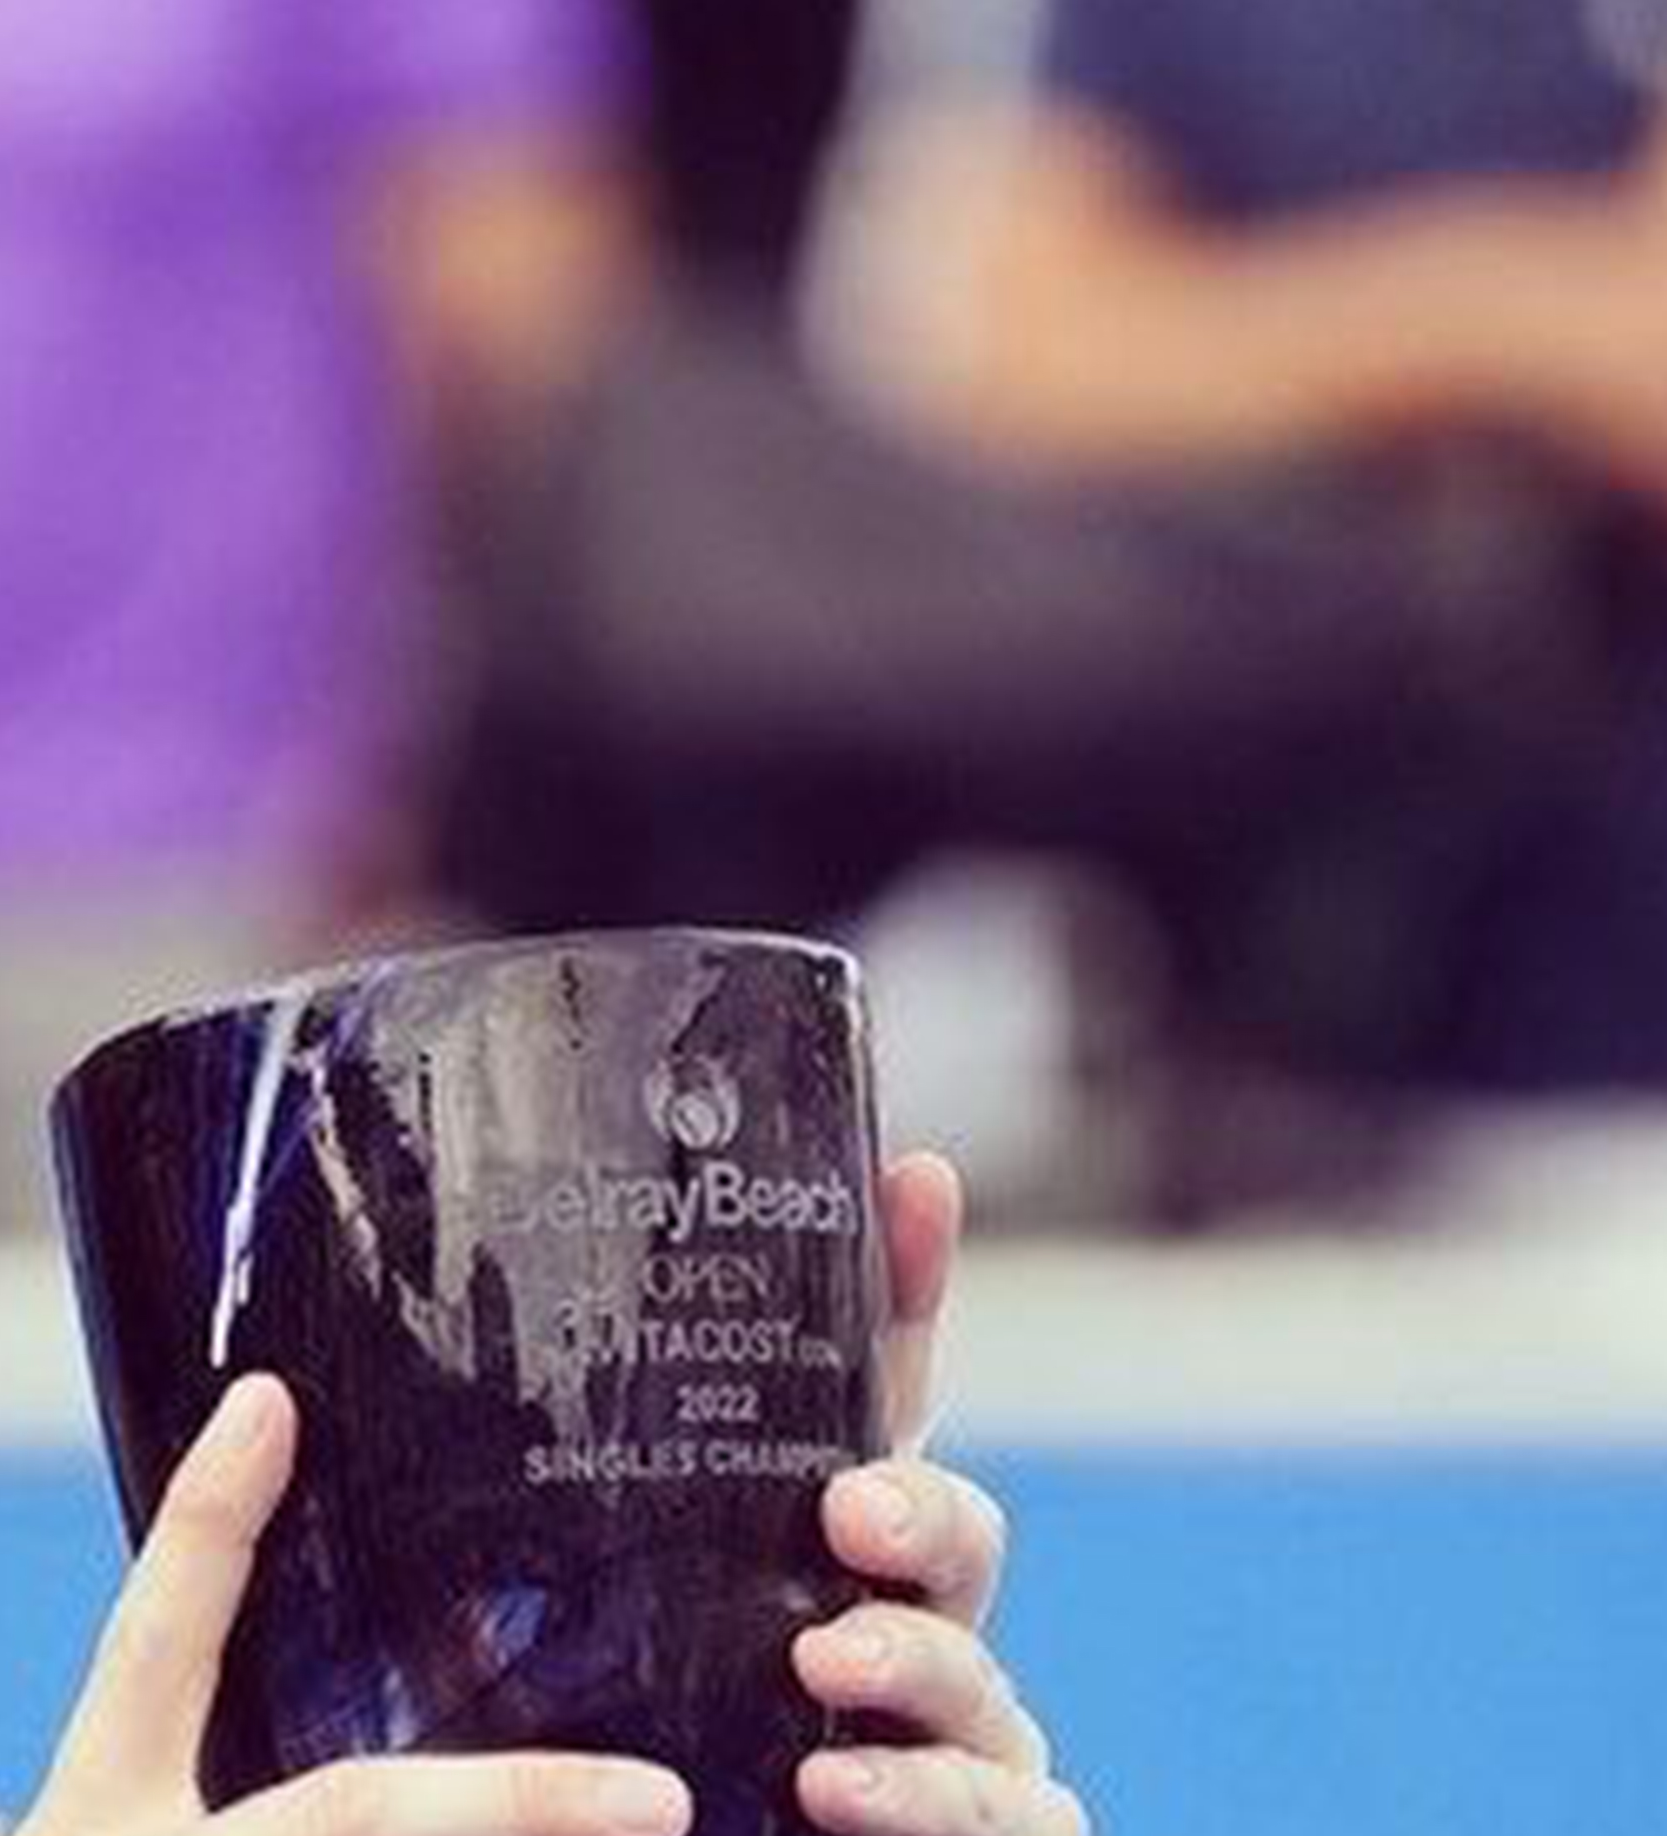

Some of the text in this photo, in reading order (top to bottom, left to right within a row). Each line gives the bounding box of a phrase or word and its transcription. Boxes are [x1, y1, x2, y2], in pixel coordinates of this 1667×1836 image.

[642, 1253, 769, 1303] OPEN
[676, 1384, 761, 1423] 2022
[522, 1440, 698, 1484] SINGLES
